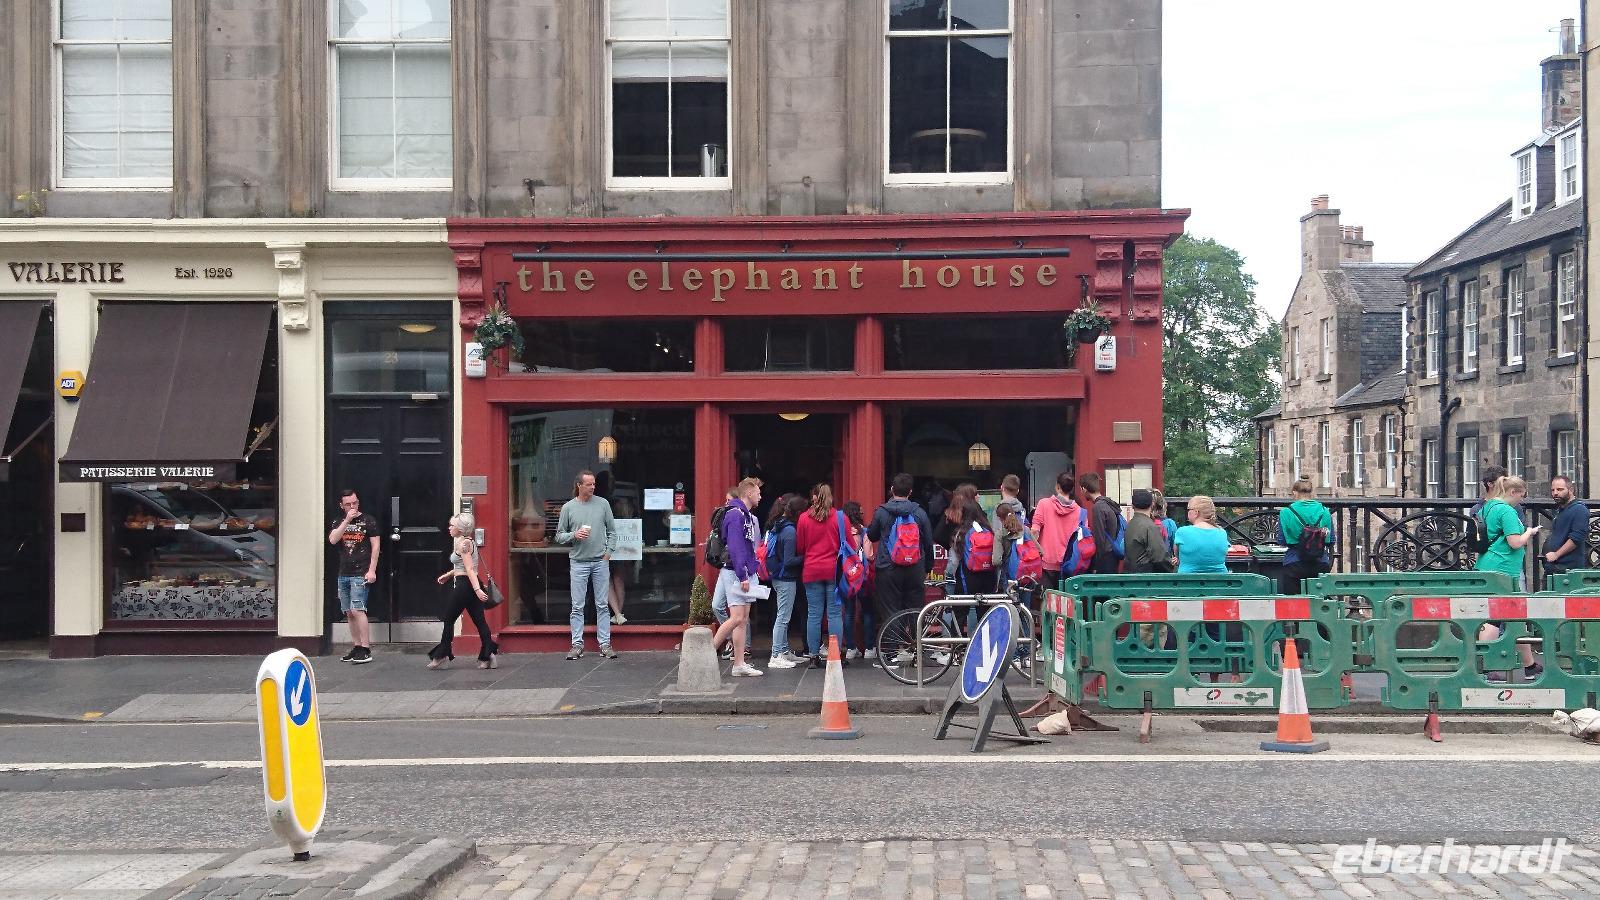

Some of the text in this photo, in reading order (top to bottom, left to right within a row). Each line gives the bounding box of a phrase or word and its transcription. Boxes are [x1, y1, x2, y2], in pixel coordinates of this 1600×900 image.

[8, 261, 125, 284] VALERIE
[174, 266, 233, 279] Est. 1926
[517, 258, 1059, 303] the elephant house
[60, 379, 75, 388] ADT
[80, 466, 214, 478] PATISSERIE VALERIE
